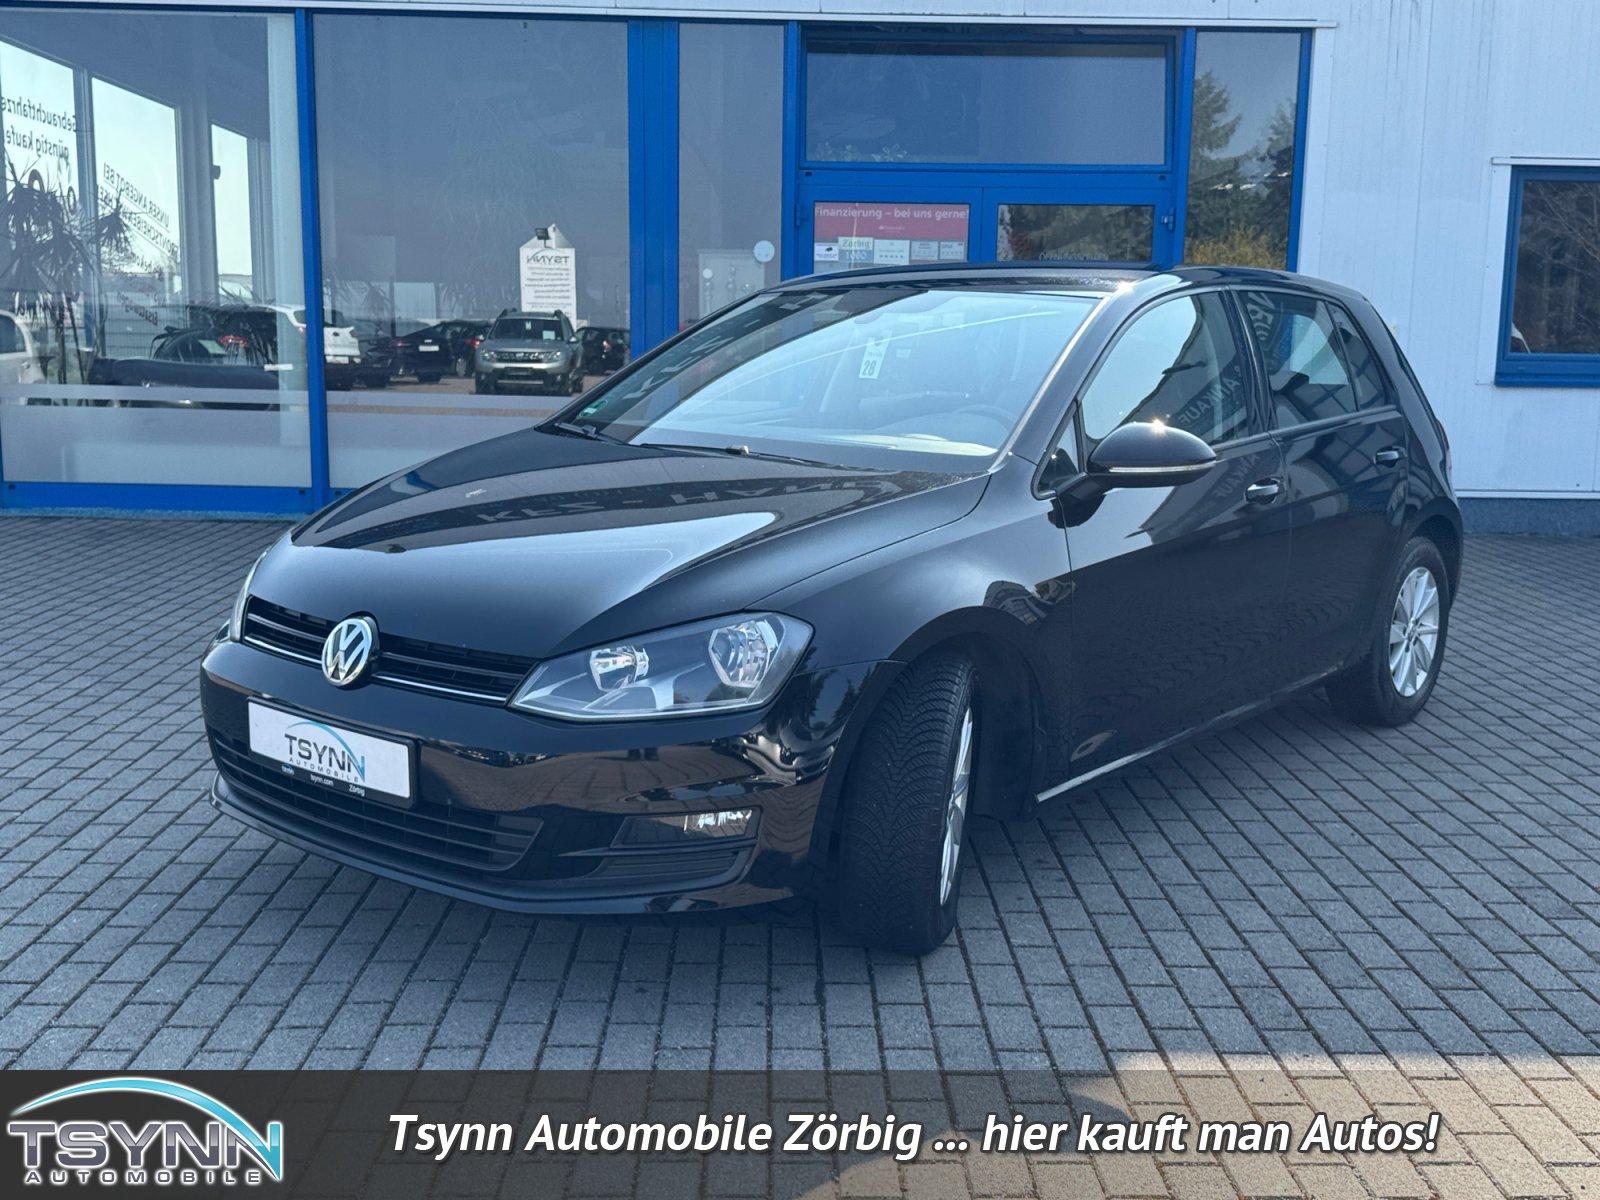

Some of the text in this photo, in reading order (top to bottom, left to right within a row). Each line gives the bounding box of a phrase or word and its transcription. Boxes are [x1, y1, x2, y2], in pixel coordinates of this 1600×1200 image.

[815, 207, 882, 220] Finanzierung
[894, 207, 910, 218] bei
[913, 209, 932, 218] uns
[284, 733, 366, 782] TSYNN
[288, 756, 360, 783] AUTOMOBILE
